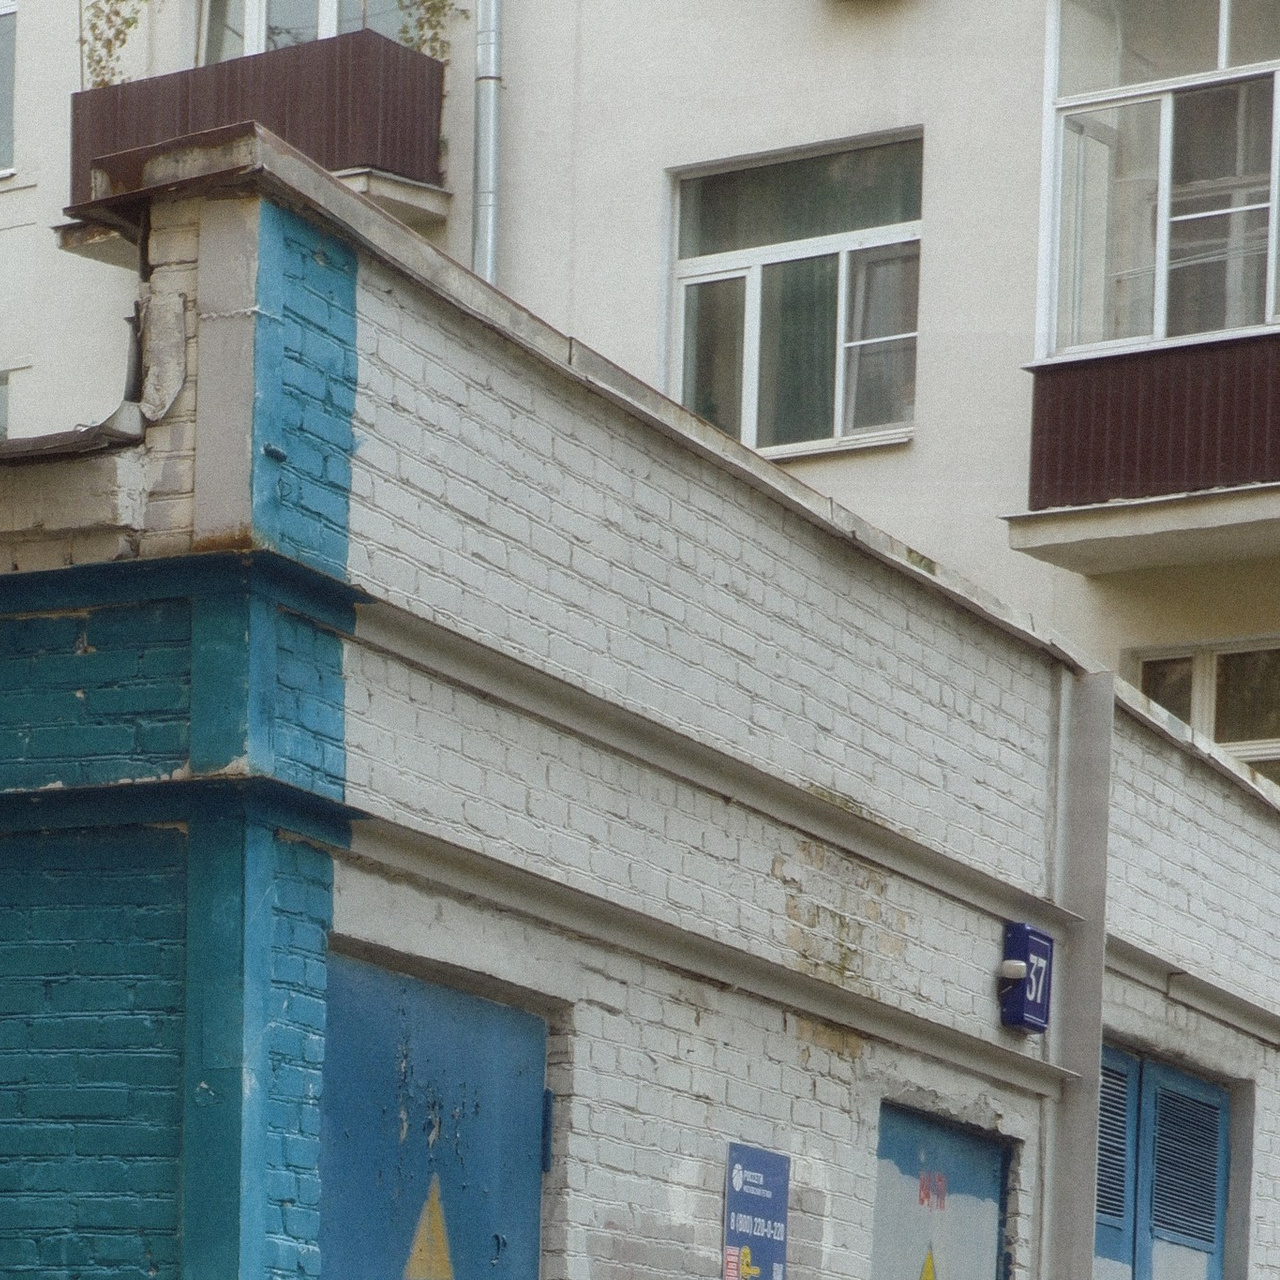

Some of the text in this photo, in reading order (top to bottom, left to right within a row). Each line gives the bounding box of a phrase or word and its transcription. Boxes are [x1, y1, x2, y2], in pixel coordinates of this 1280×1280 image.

[1026, 953, 1047, 1004] 37
[730, 1211, 736, 1231] 8
[753, 1217, 786, 1241] 220-0-220
